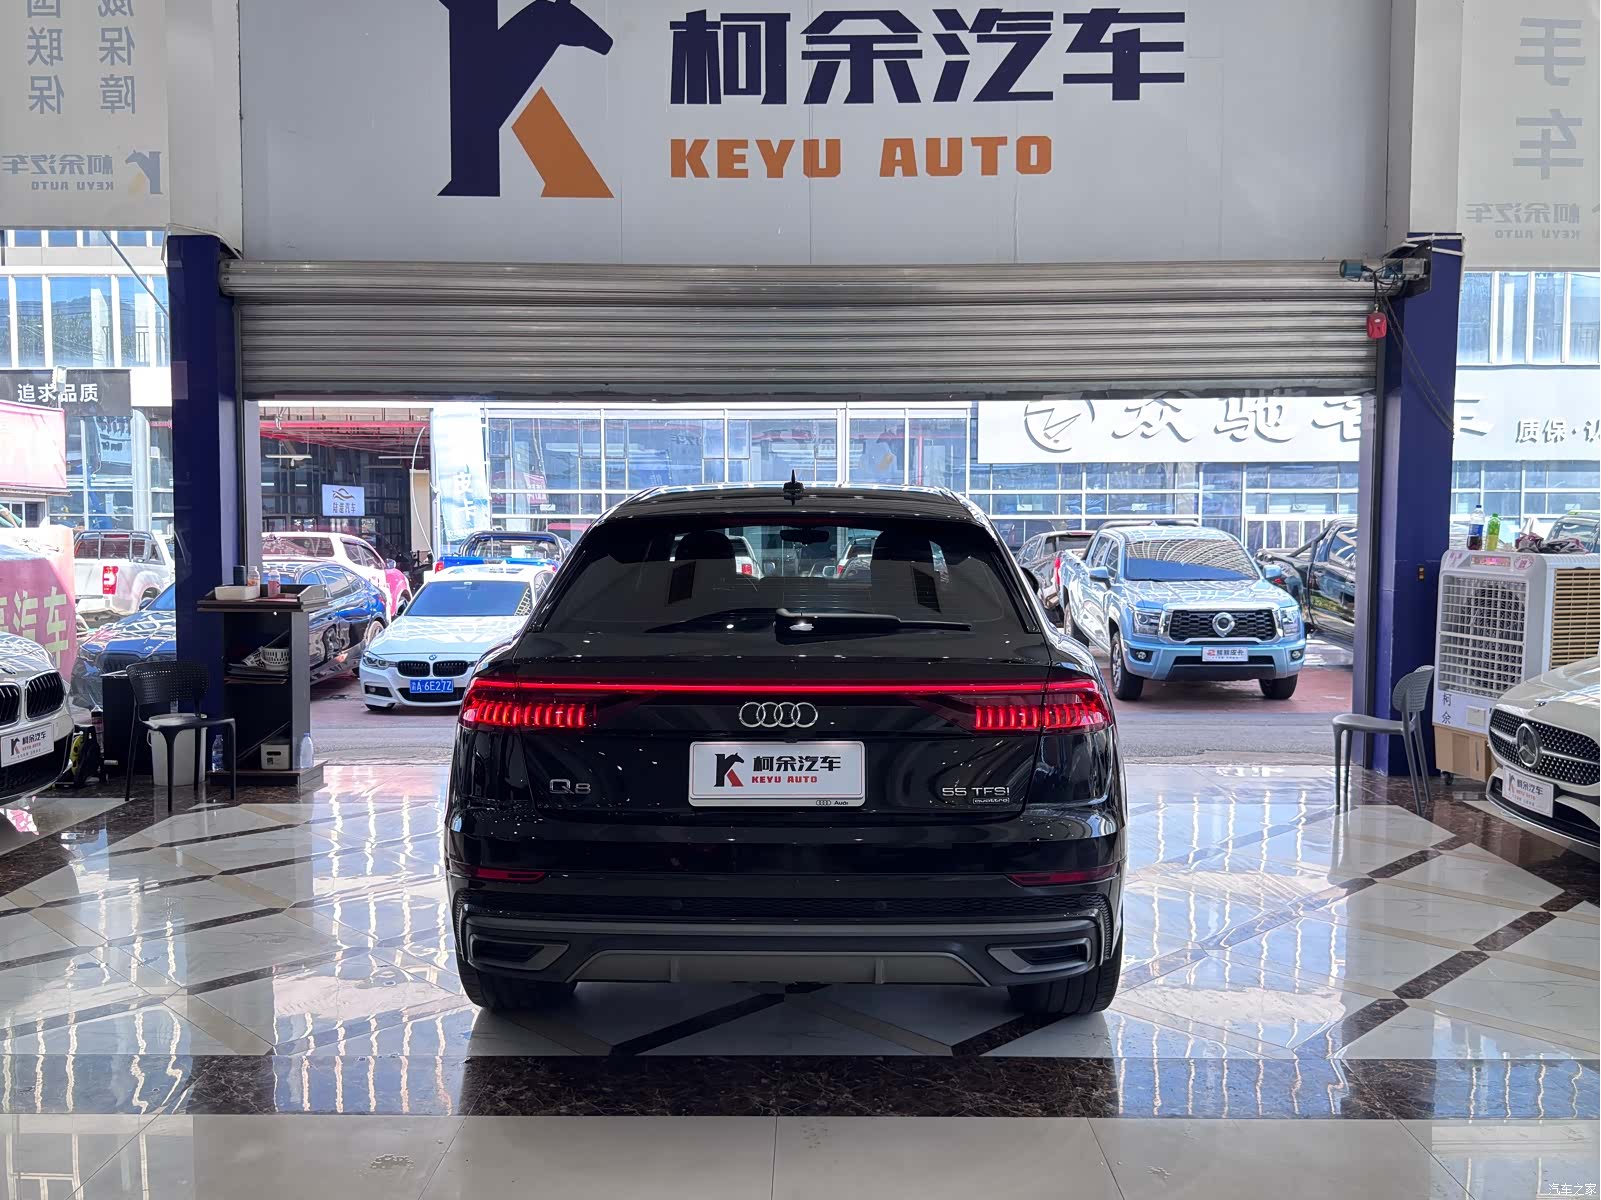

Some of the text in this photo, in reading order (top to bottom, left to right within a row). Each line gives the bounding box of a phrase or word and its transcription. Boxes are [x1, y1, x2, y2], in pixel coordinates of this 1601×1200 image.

[670, 8, 1186, 105] 柯余汽车
[670, 135, 1052, 179] KEYU AUTO
[17, 383, 99, 403] 追求品质
[753, 756, 841, 772] 柯余汽车
[550, 779, 591, 794] Q8
[942, 786, 1010, 796] 55 TFSI
